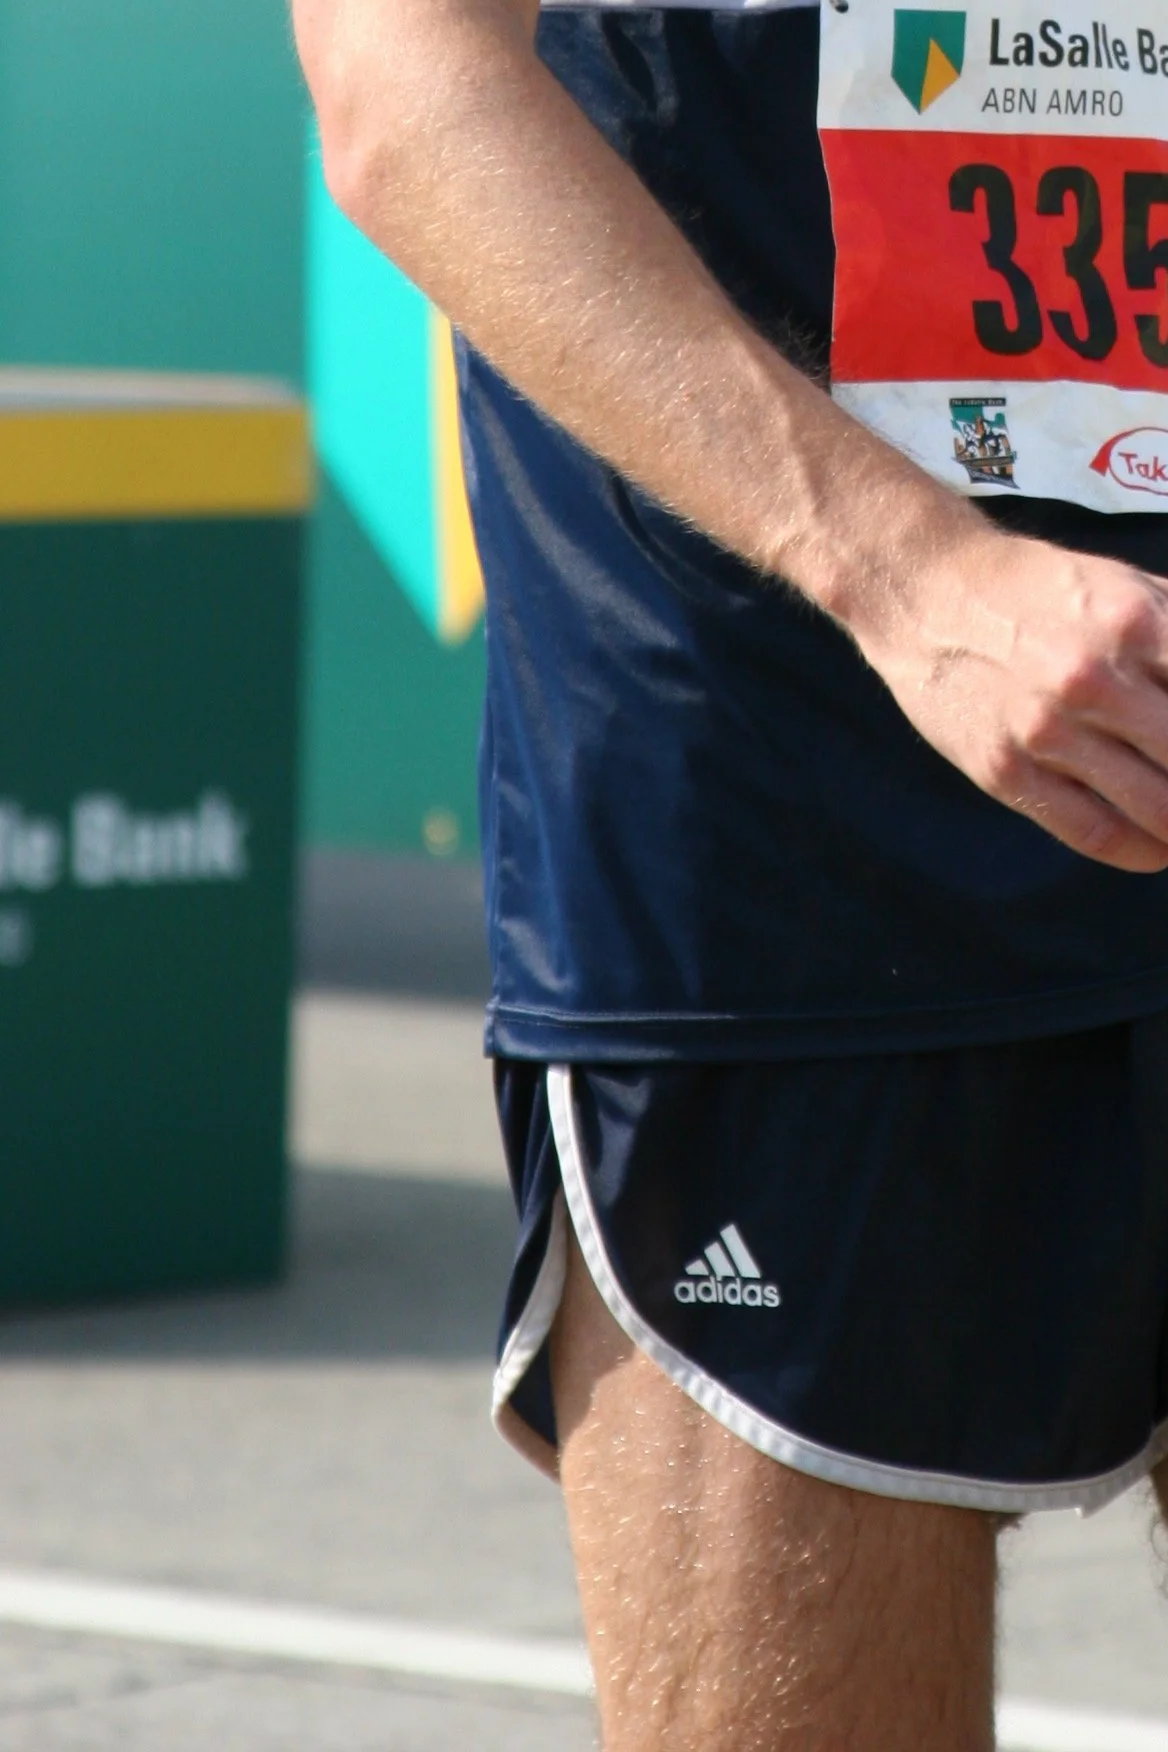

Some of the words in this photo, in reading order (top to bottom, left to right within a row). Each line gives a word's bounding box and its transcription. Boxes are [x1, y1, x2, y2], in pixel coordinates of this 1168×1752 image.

[989, 17, 1130, 71] LaSalle
[981, 87, 1037, 115] ABN
[1046, 88, 1124, 117] AMRO
[73, 792, 248, 888] Bank
[674, 1276, 781, 1308] adidas
